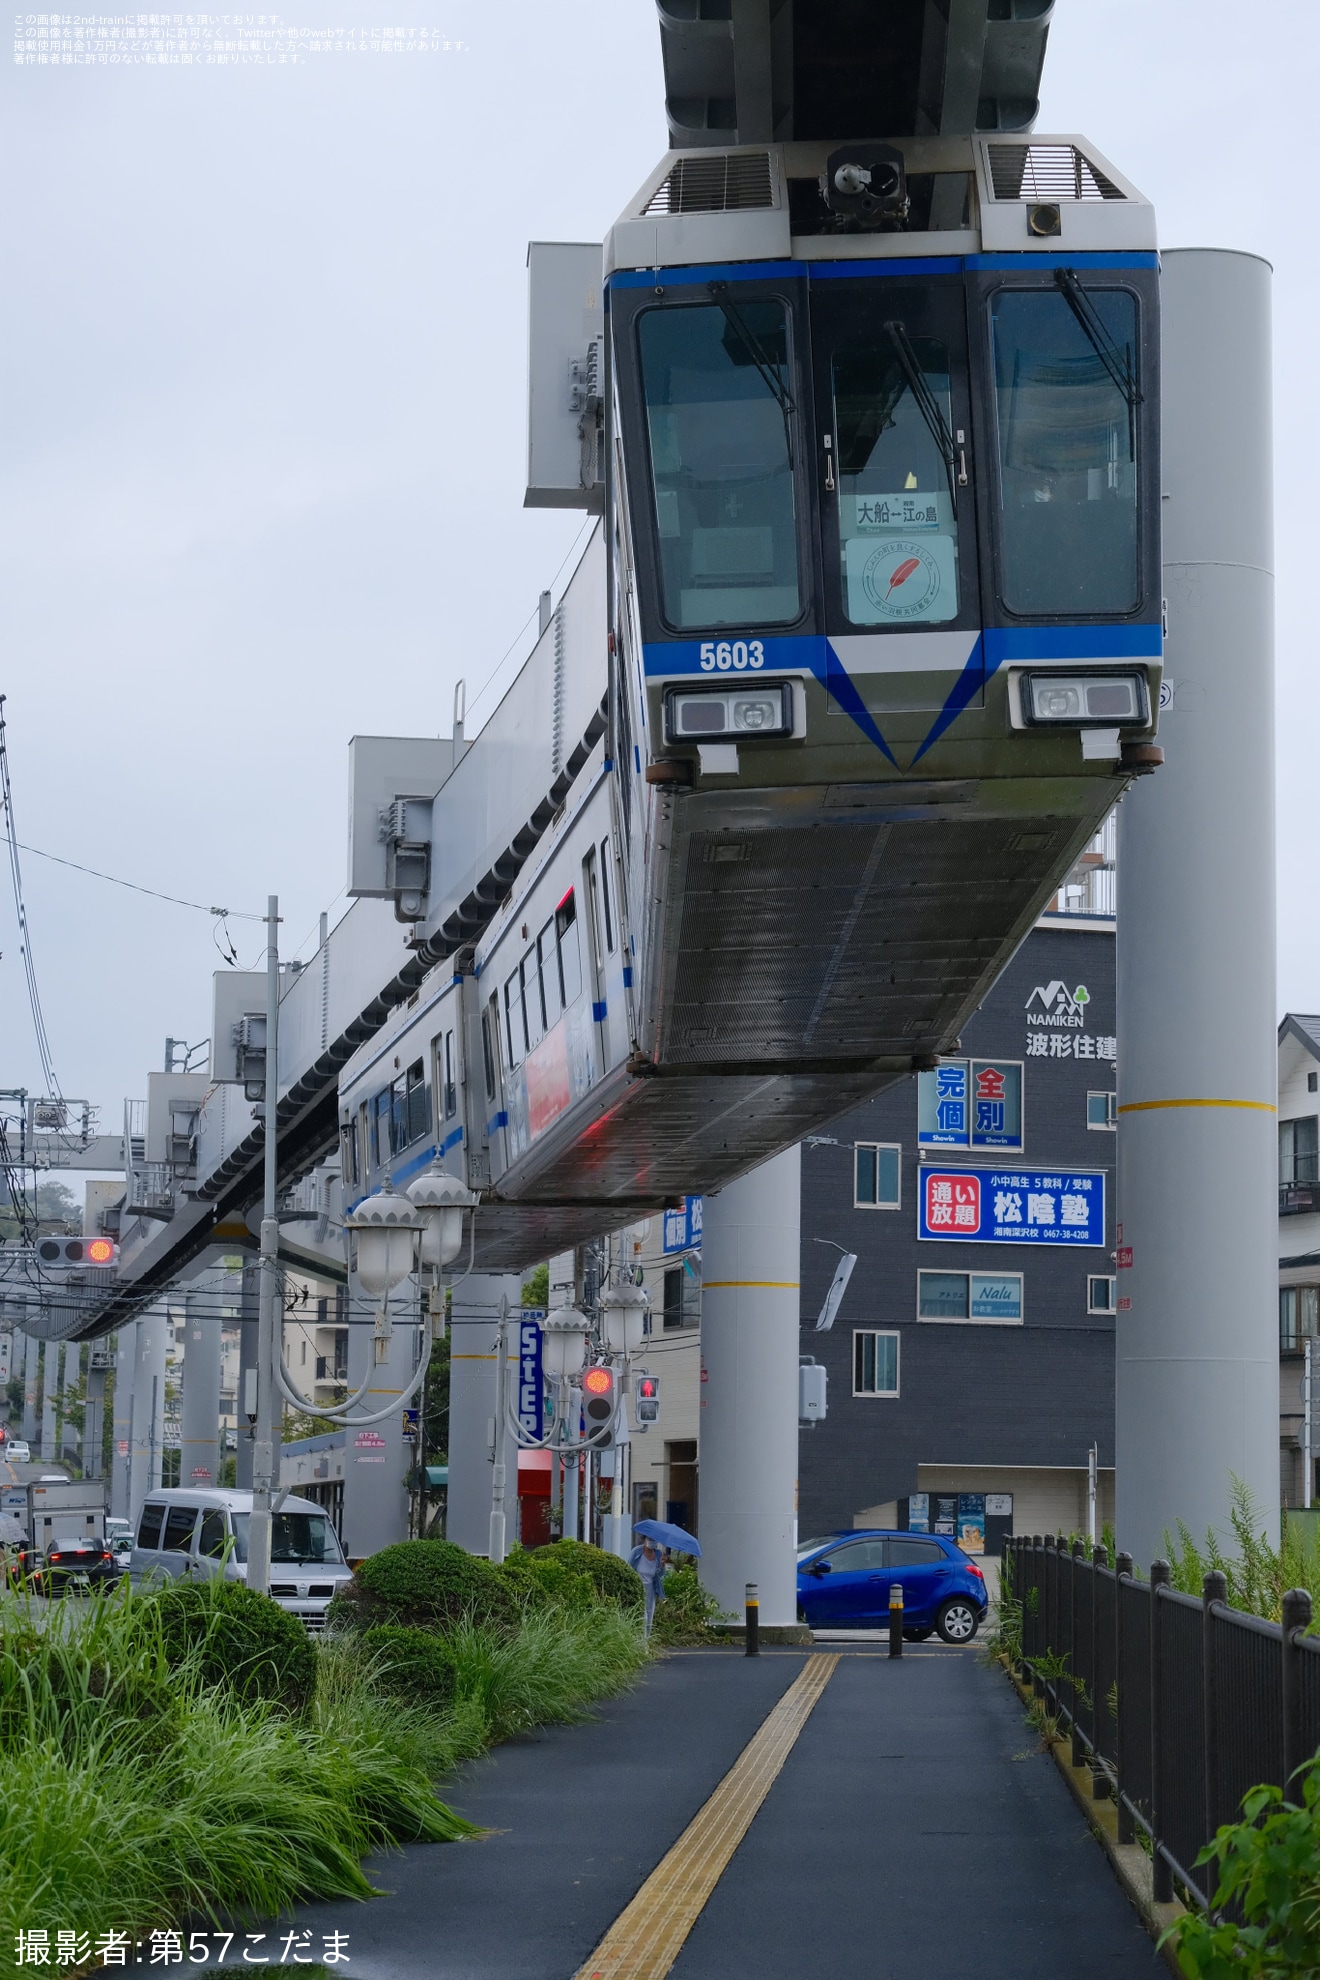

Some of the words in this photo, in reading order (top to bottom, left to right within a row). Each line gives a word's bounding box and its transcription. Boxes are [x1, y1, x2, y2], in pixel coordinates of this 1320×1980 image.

[857, 501, 890, 524] 大船
[903, 505, 937, 523] 江の島
[700, 640, 765, 671] 5603
[1026, 1013, 1085, 1028] NAMIKEN
[1026, 1031, 1117, 1061] 波形住建
[931, 1181, 976, 1204] 通い
[990, 1175, 1030, 1188] 小中高生
[931, 1204, 976, 1226] 放題
[993, 1191, 1090, 1226] 松陰塾
[993, 1226, 1039, 1238] 湘南深沢校
[1043, 1229, 1090, 1239] 0467-38-4208
[979, 1285, 1012, 1300] Nalu
